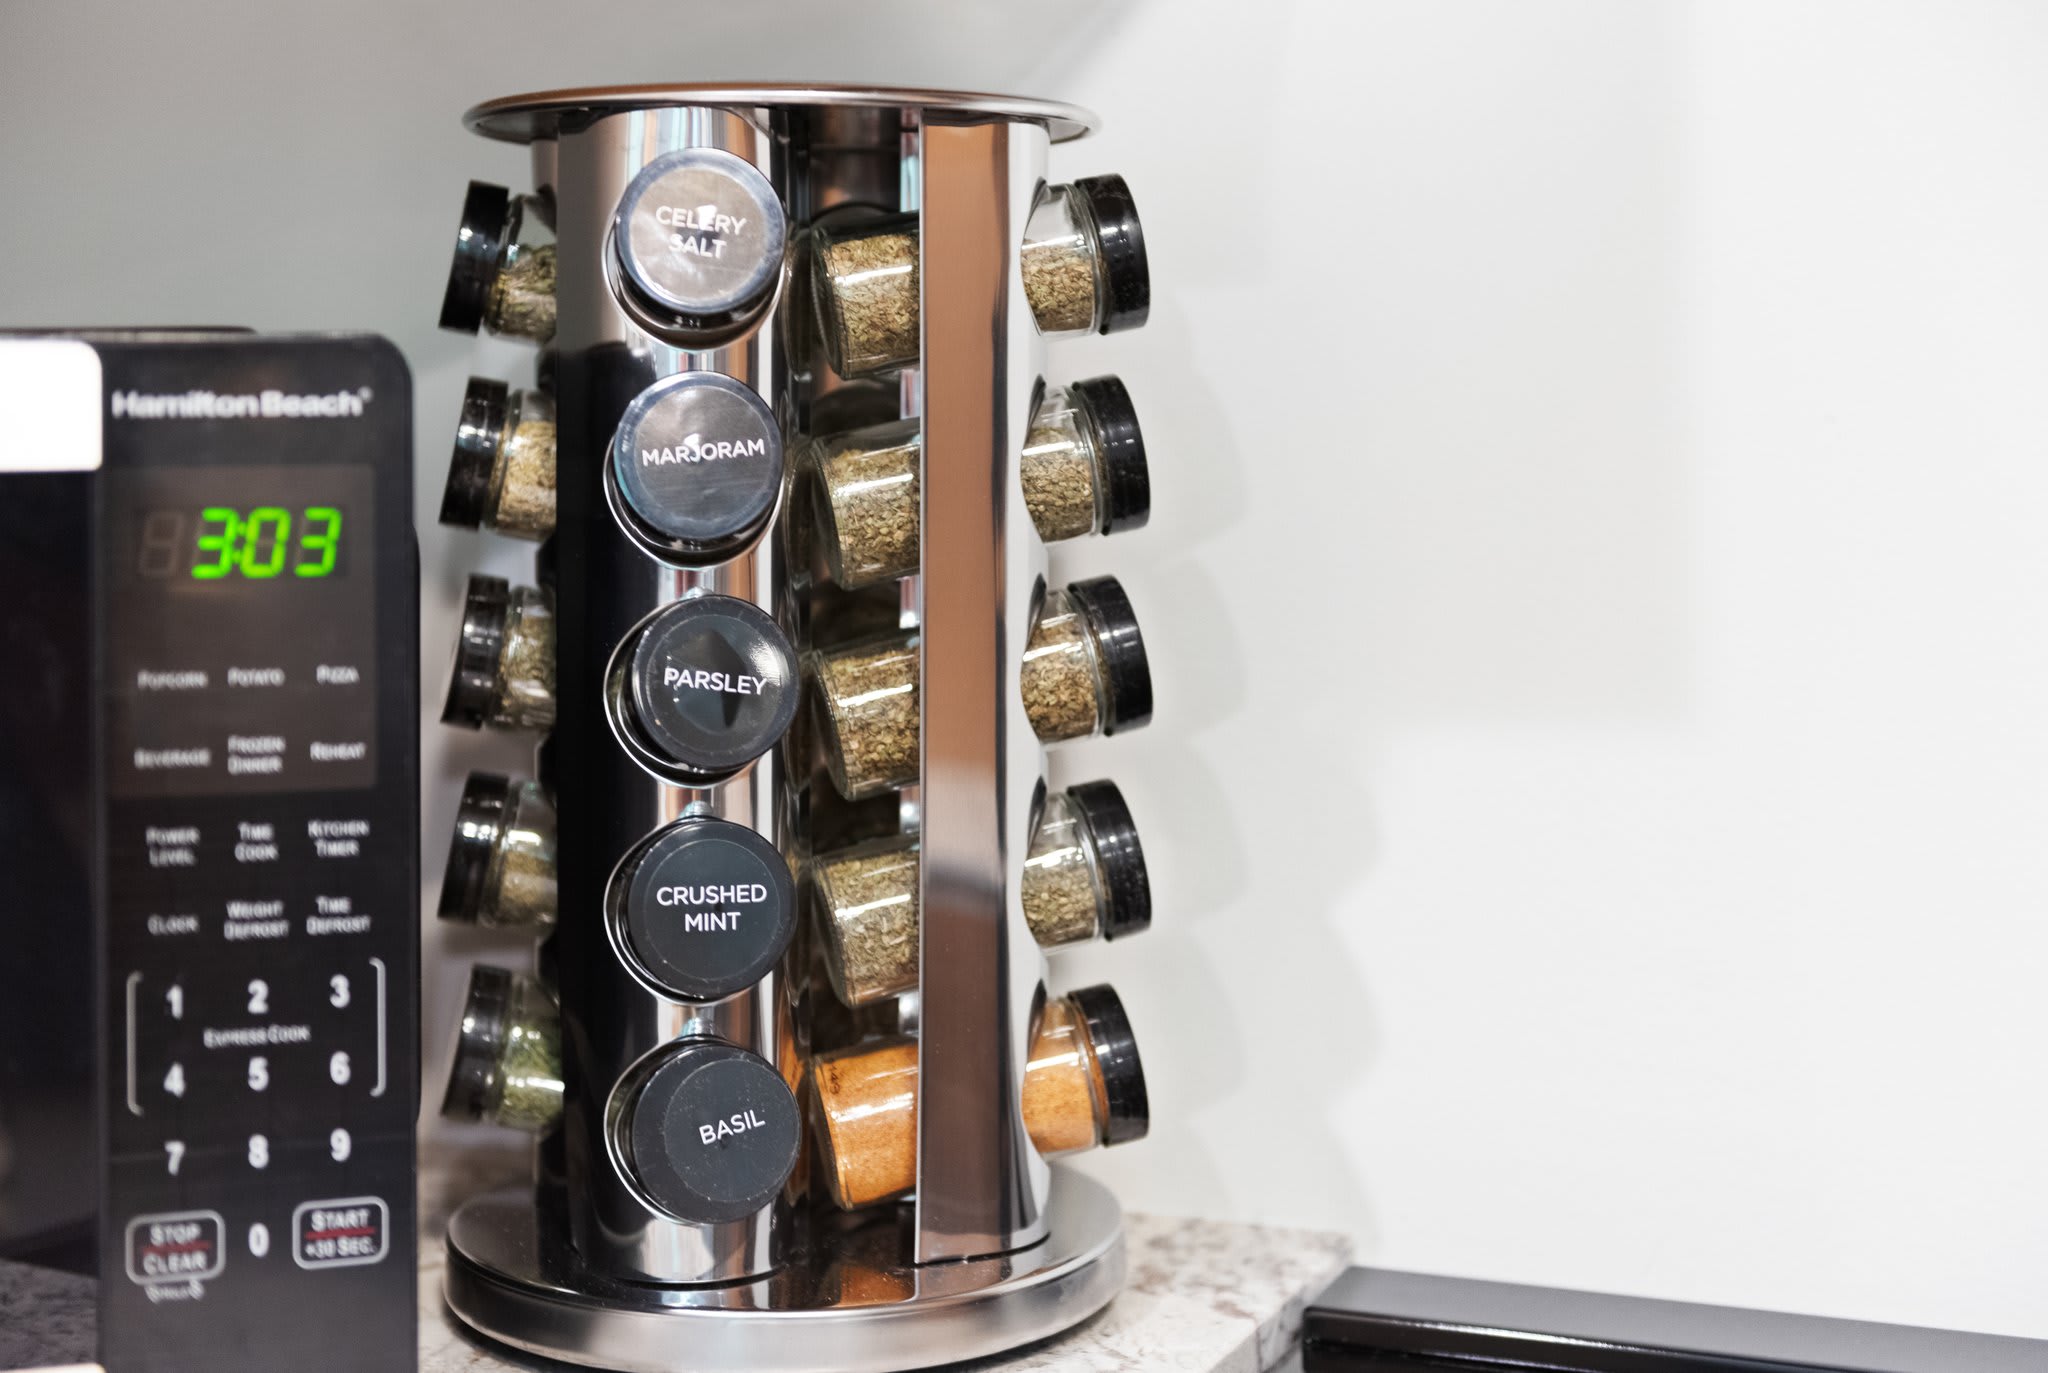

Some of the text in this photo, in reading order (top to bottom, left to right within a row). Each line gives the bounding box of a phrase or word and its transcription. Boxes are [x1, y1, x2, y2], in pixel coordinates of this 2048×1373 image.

[655, 205, 748, 237] CELERY
[668, 232, 728, 260] SALT
[111, 389, 259, 418] Hamilton
[641, 436, 766, 467] MARJORAM
[191, 507, 343, 579] 3:03
[663, 667, 768, 696] PARSLEY
[656, 883, 767, 906] CRUSHED
[684, 911, 741, 933] MINT
[166, 984, 183, 1020] 1
[247, 979, 269, 1014] 2
[329, 973, 350, 1009] 3
[163, 1062, 186, 1097] 4
[247, 1056, 269, 1092] 5
[329, 1051, 351, 1086] 6
[329, 1127, 351, 1163] 9
[698, 1109, 766, 1146] BASIL
[164, 1140, 186, 1176] 7
[247, 1133, 270, 1169] 8
[150, 1223, 202, 1246] STOP
[310, 1208, 371, 1233] START
[143, 1252, 207, 1275] CLEAR
